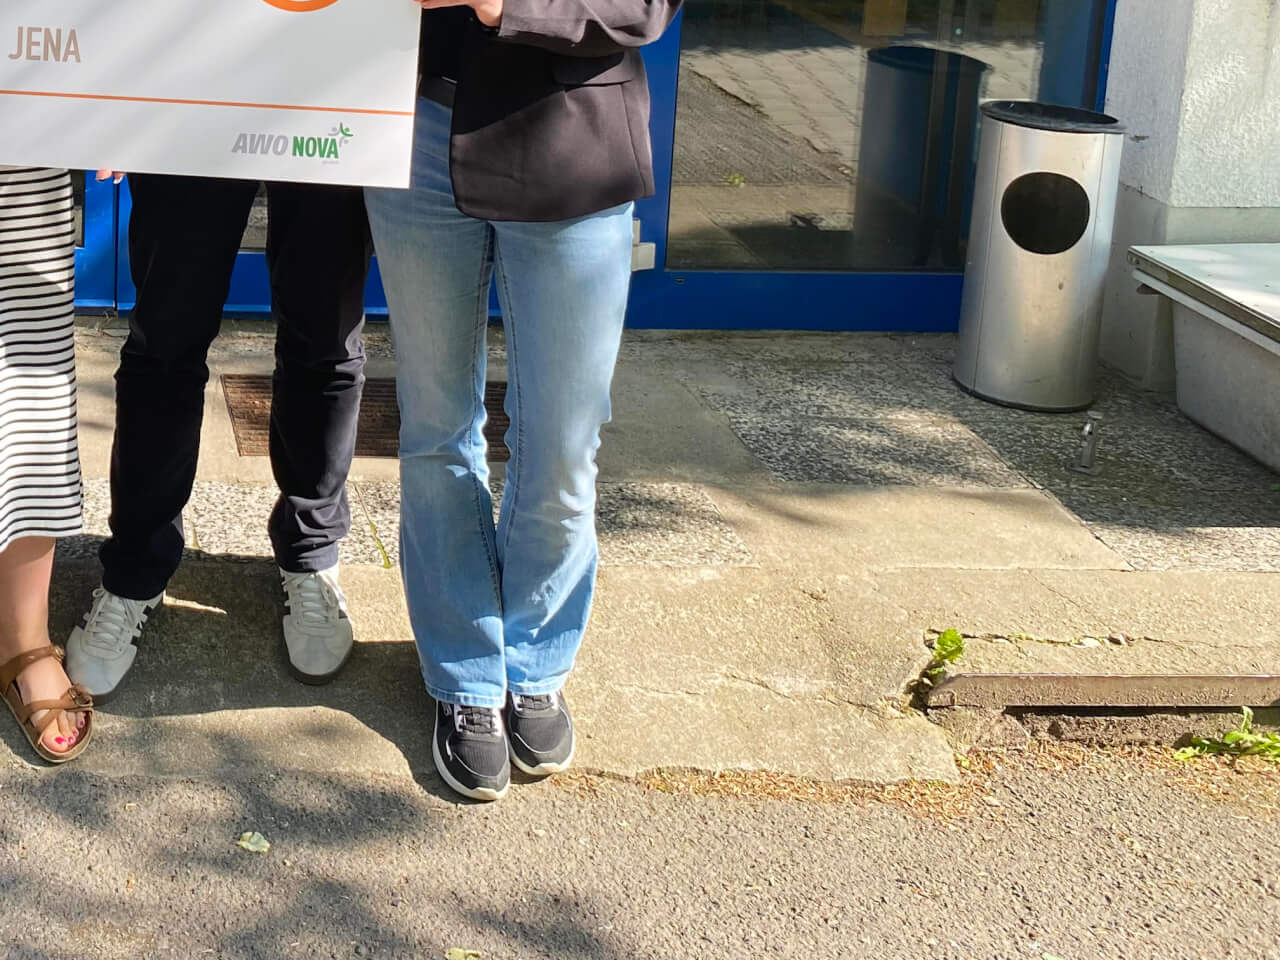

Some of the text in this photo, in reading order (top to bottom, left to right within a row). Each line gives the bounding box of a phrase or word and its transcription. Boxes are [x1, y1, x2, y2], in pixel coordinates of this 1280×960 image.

[8, 25, 81, 63] JENA
[231, 132, 340, 159] AWO NOVA
